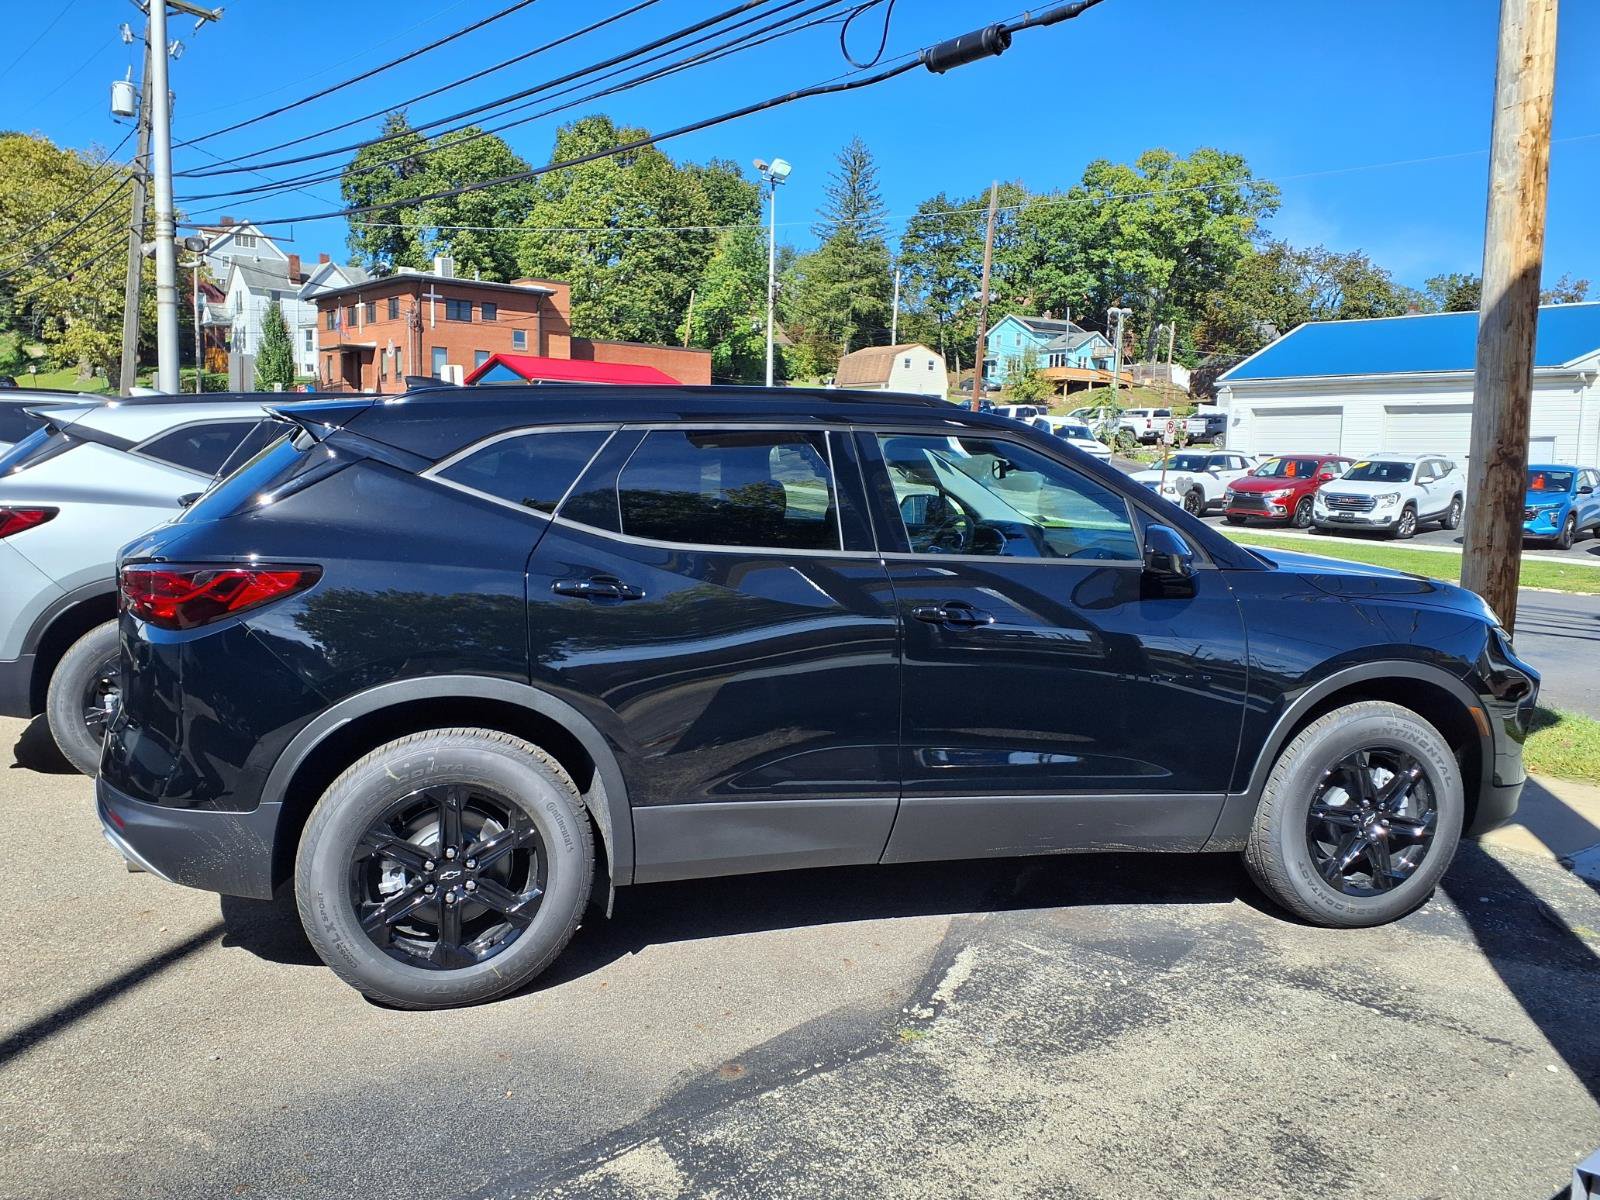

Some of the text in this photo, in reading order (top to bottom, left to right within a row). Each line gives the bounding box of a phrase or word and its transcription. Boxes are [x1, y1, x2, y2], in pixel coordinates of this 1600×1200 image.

[1359, 728, 1452, 787] CONTINENTAL
[546, 801, 573, 847] Continental
[317, 890, 329, 922] SPORT
[335, 942, 358, 969] CROSS
